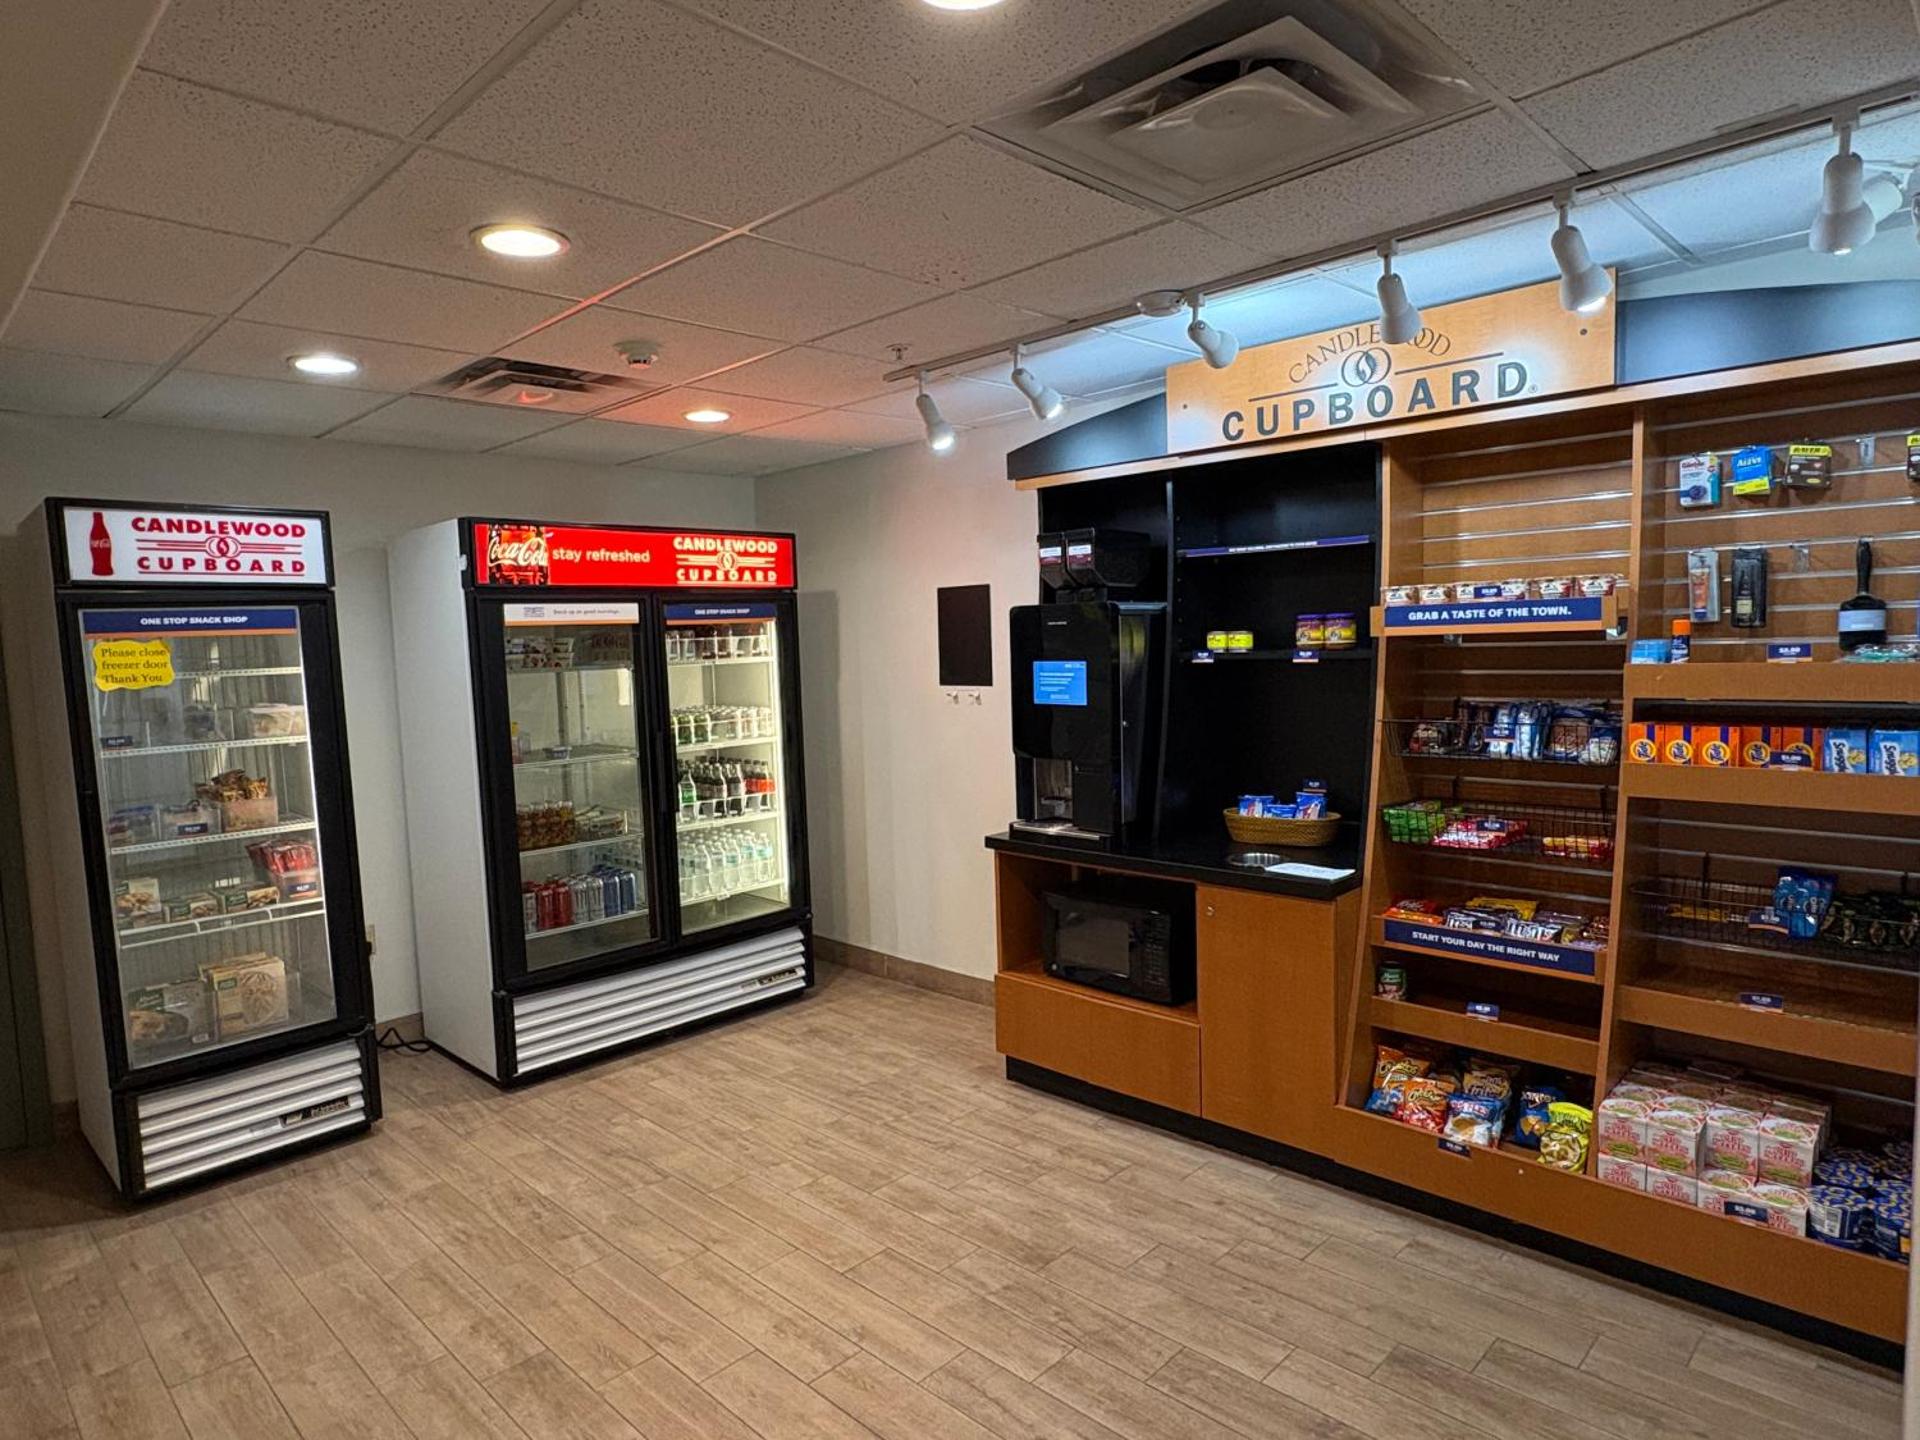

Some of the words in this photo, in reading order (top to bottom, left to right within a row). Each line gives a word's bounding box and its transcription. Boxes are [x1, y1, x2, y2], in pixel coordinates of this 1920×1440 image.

[1289, 323, 1452, 385] CANDLEOD
[1221, 360, 1528, 442] CUPBOARD
[131, 516, 306, 538] CANDLEWOOD
[673, 536, 778, 554] CANDLEWOOD
[552, 548, 581, 562] stay
[585, 548, 650, 562] refreshed
[137, 556, 306, 572] CUPBOARD
[676, 568, 777, 582] CUPBOARD
[140, 617, 161, 626] ONE
[163, 617, 188, 625] STOP
[189, 616, 221, 624] SNACK
[223, 615, 249, 623] SHOP
[1408, 611, 1439, 621] GRAB
[1441, 611, 1449, 620] A
[1451, 610, 1486, 619] TASTE
[1488, 609, 1504, 618] OF
[1506, 607, 1529, 617] THE
[1532, 606, 1572, 616] TOWN.
[102, 647, 136, 657] Please
[139, 647, 167, 657] close
[102, 660, 141, 669] freezer
[143, 659, 168, 669] door
[103, 673, 138, 683] Thank
[141, 673, 163, 682] You
[1412, 931, 1439, 942] START
[1441, 936, 1465, 947] YOUR
[1467, 940, 1485, 950] DAY
[1487, 943, 1505, 953] THE
[1507, 946, 1536, 958] RIGHT
[1538, 951, 1560, 962] WAY
